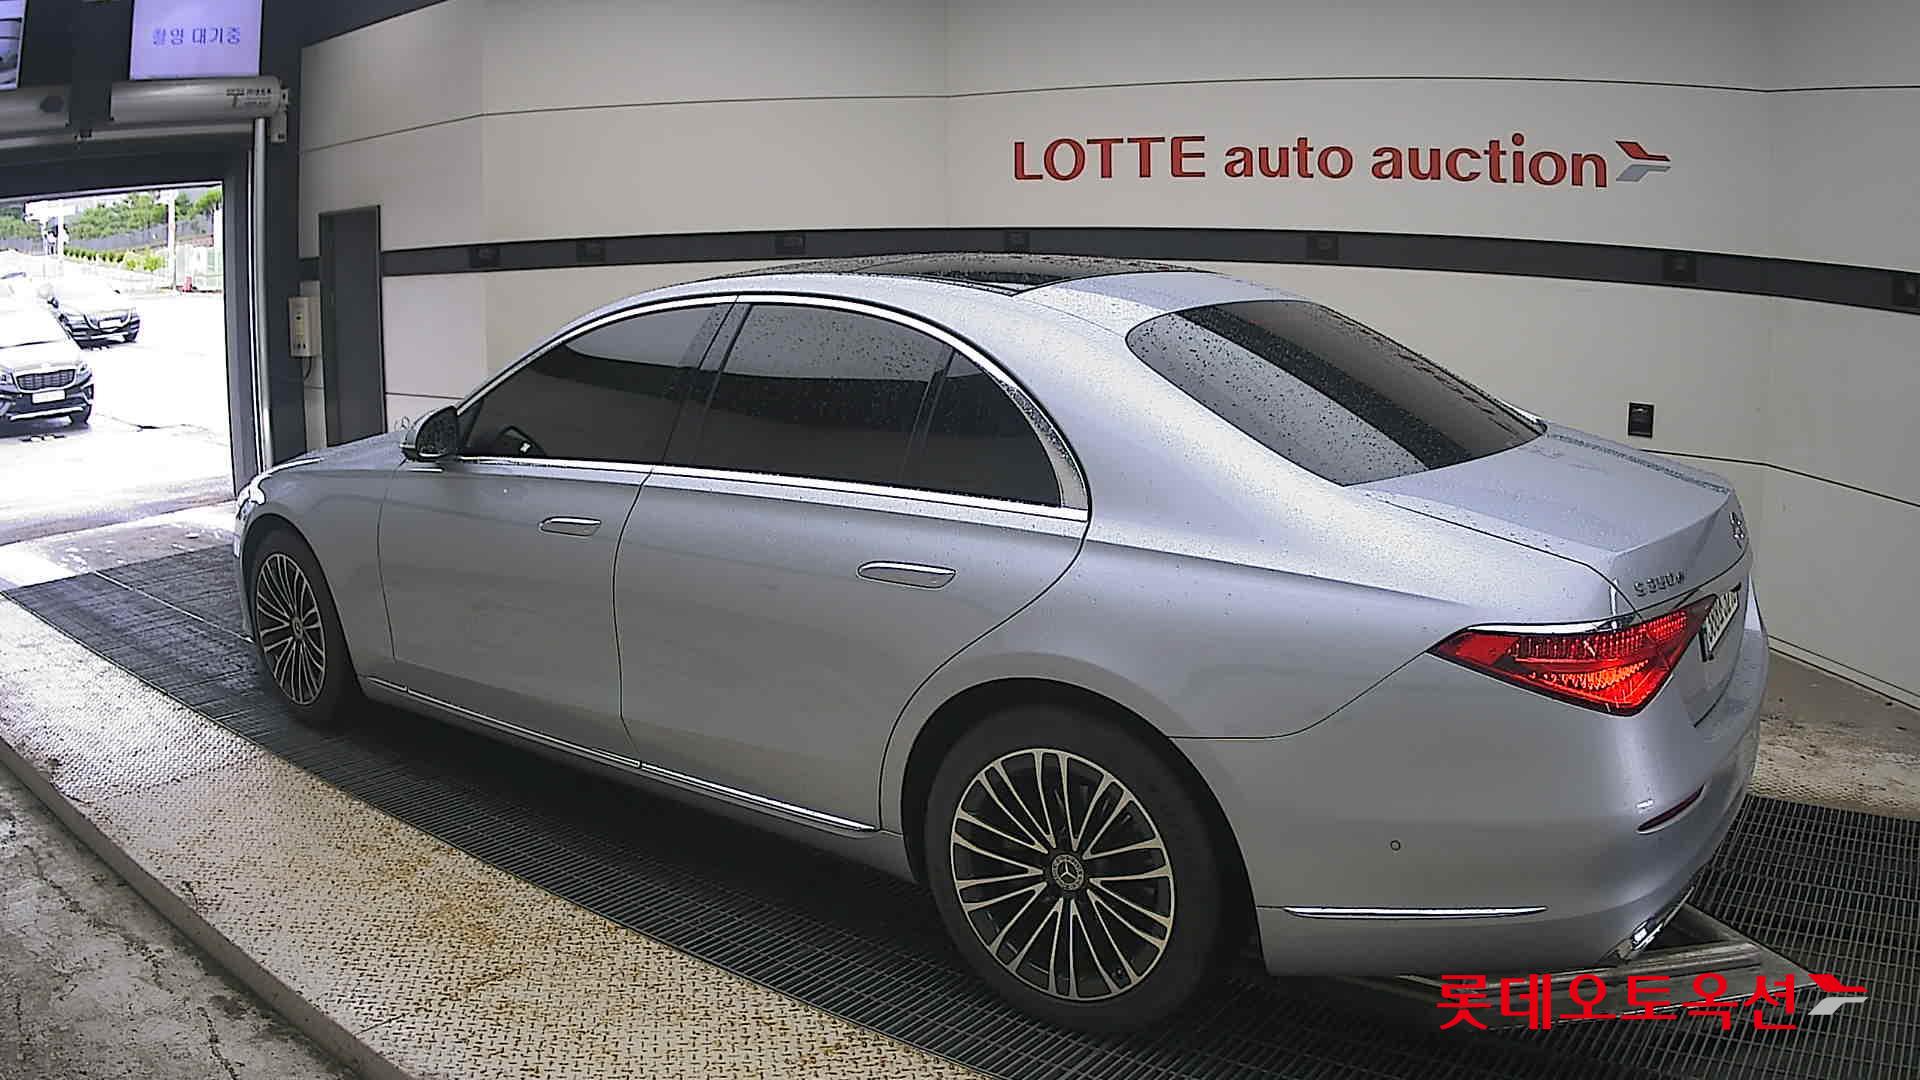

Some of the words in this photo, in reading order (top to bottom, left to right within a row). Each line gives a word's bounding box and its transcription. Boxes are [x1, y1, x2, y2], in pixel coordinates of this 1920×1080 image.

[192, 27, 241, 45] 대기중
[1014, 136, 1206, 181] LOTTE
[1224, 137, 1354, 179] auto
[1371, 132, 1608, 188] auction
